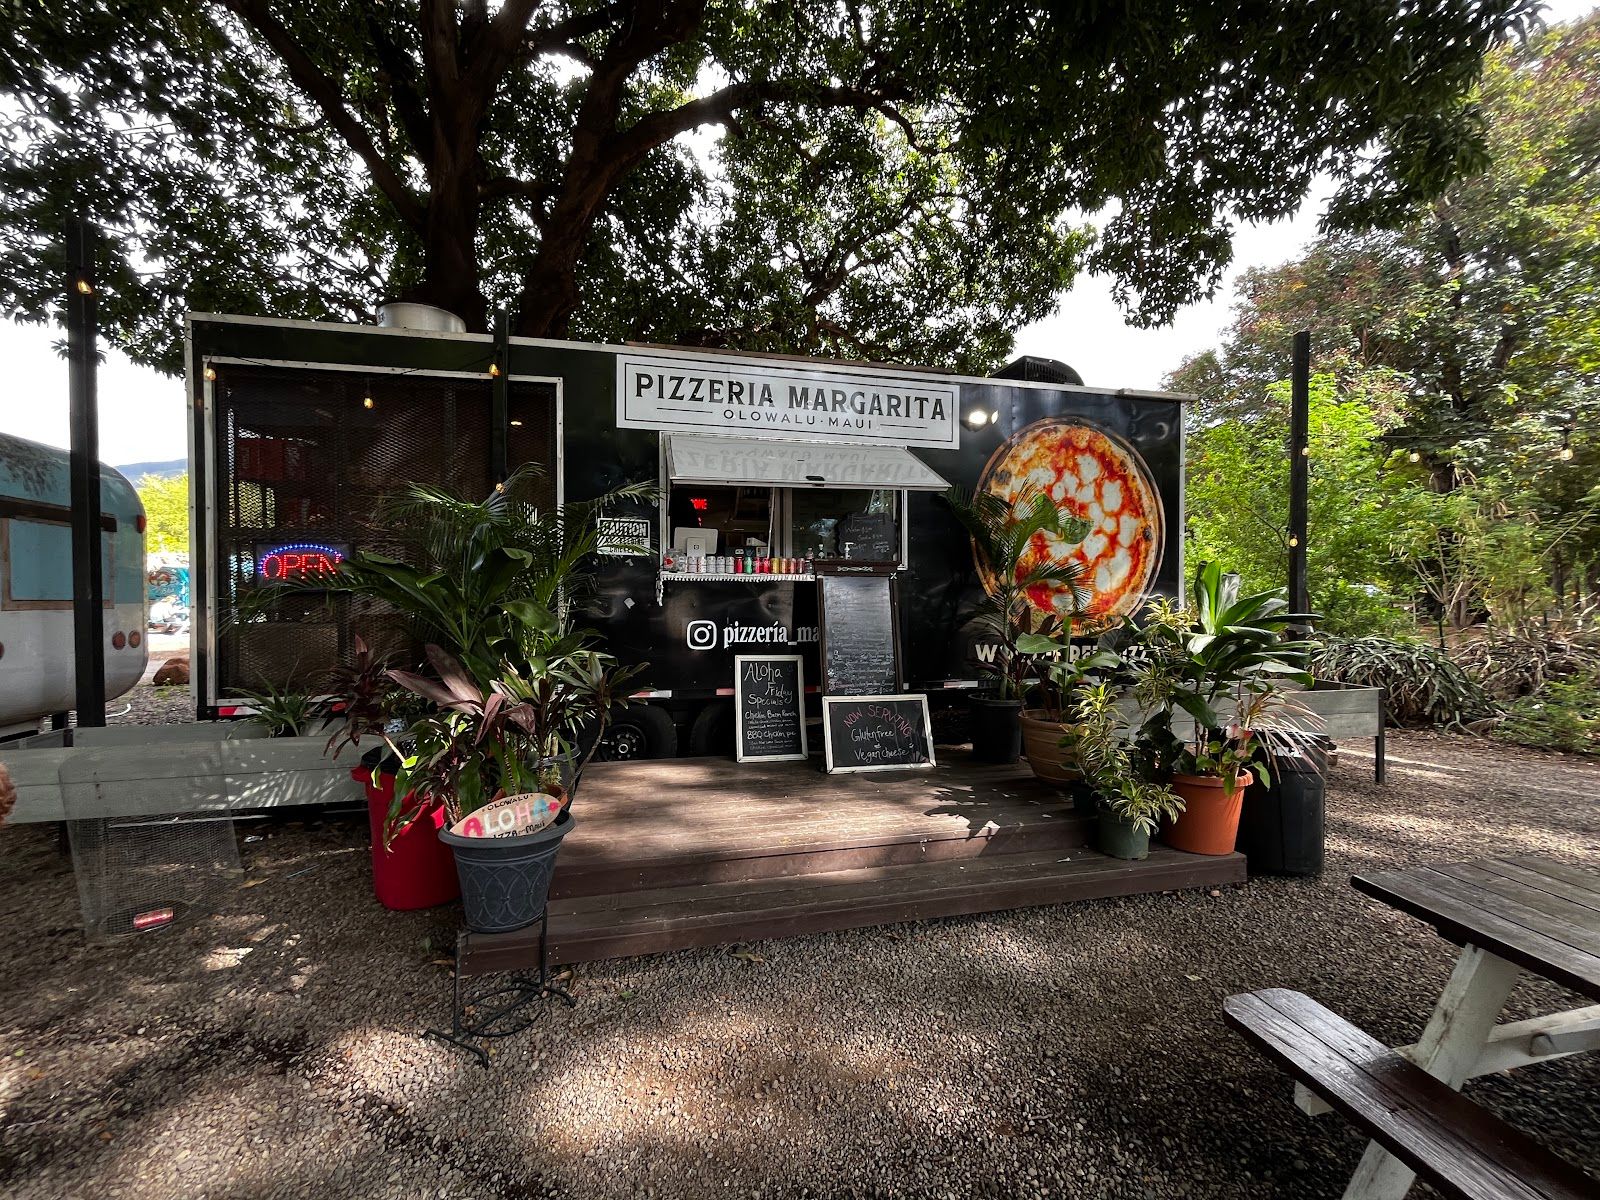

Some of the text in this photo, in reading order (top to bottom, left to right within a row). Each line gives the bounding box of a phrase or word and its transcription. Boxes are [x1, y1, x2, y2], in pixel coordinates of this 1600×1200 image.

[635, 373, 946, 420] PIZZERIA MARGARITA
[601, 521, 647, 536] CAUTION
[261, 553, 340, 580] OPEN
[748, 694, 783, 709] Specials
[765, 682, 793, 704] Friday
[843, 704, 913, 738] NOW SERVING
[747, 730, 763, 739] BBQ
[487, 794, 529, 811] OLOWALU
[463, 798, 549, 838] ALOHA
